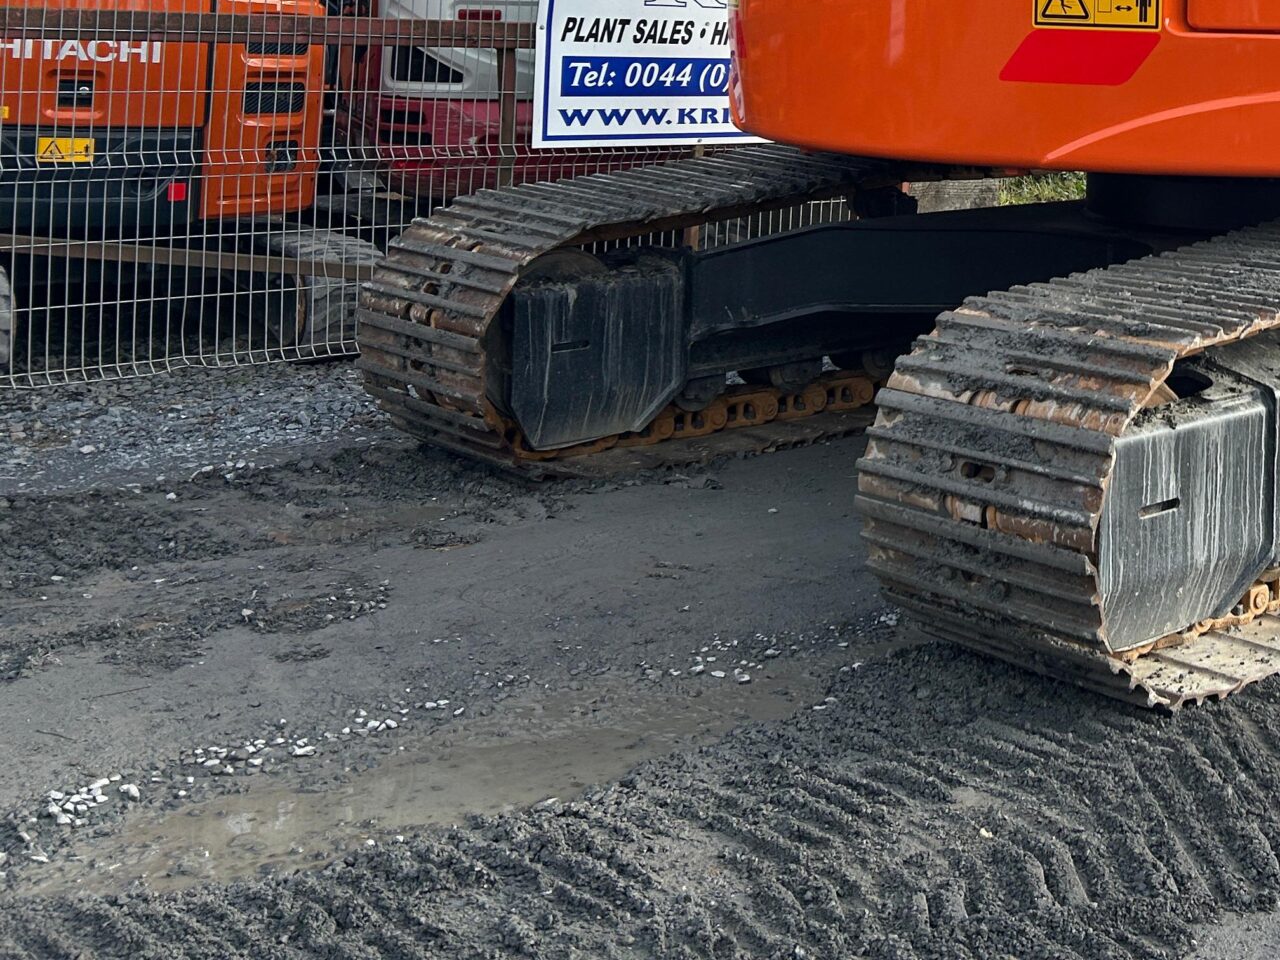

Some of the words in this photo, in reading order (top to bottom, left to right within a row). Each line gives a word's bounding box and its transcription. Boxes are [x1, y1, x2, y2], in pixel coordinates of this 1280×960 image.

[561, 17, 631, 42] PLANT
[632, 19, 695, 45] SALES
[0, 38, 162, 64] HITACHI
[568, 62, 616, 87] Tel:
[624, 63, 693, 88] 0044
